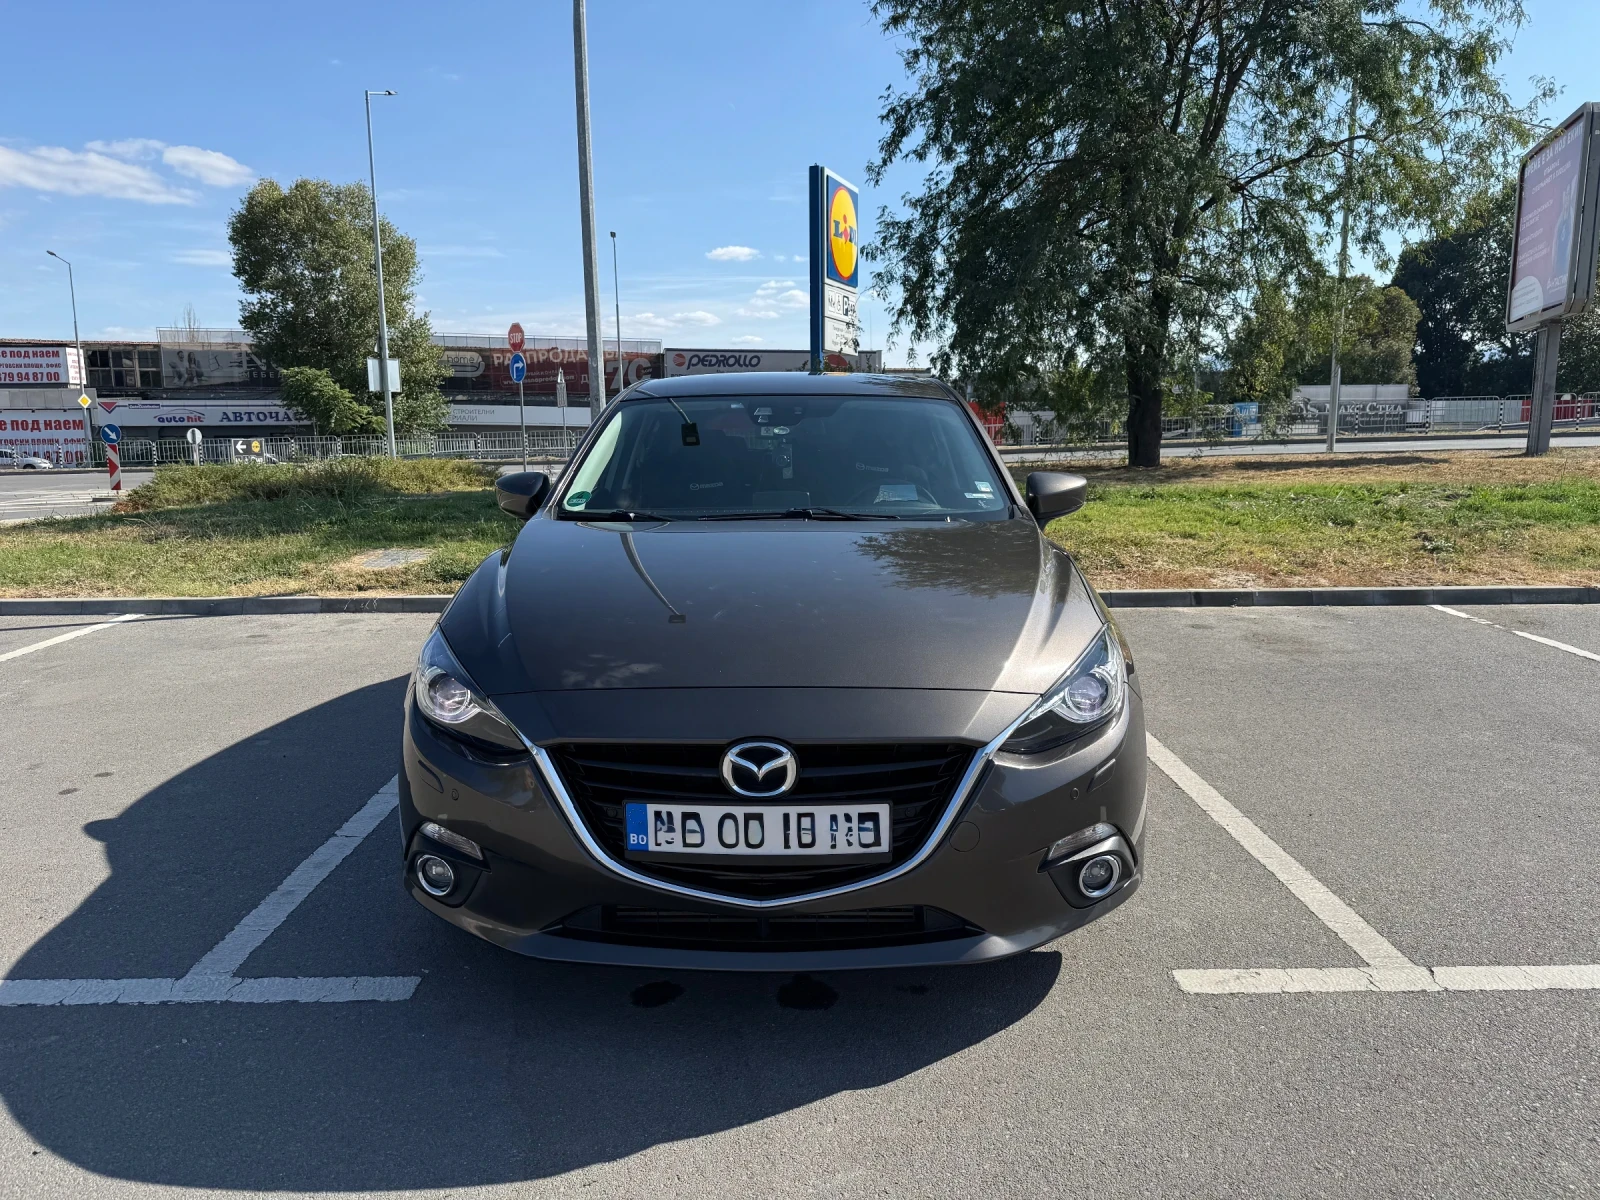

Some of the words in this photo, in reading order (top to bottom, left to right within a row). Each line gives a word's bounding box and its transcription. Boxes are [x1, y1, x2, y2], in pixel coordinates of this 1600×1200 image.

[510, 332, 522, 344] STOP
[9, 350, 31, 360] под
[32, 350, 60, 358] наем
[447, 354, 475, 364] home
[16, 371, 31, 382] 94
[32, 371, 44, 382] 87
[46, 371, 60, 382] 00
[10, 419, 41, 433] под
[43, 419, 84, 431] наем
